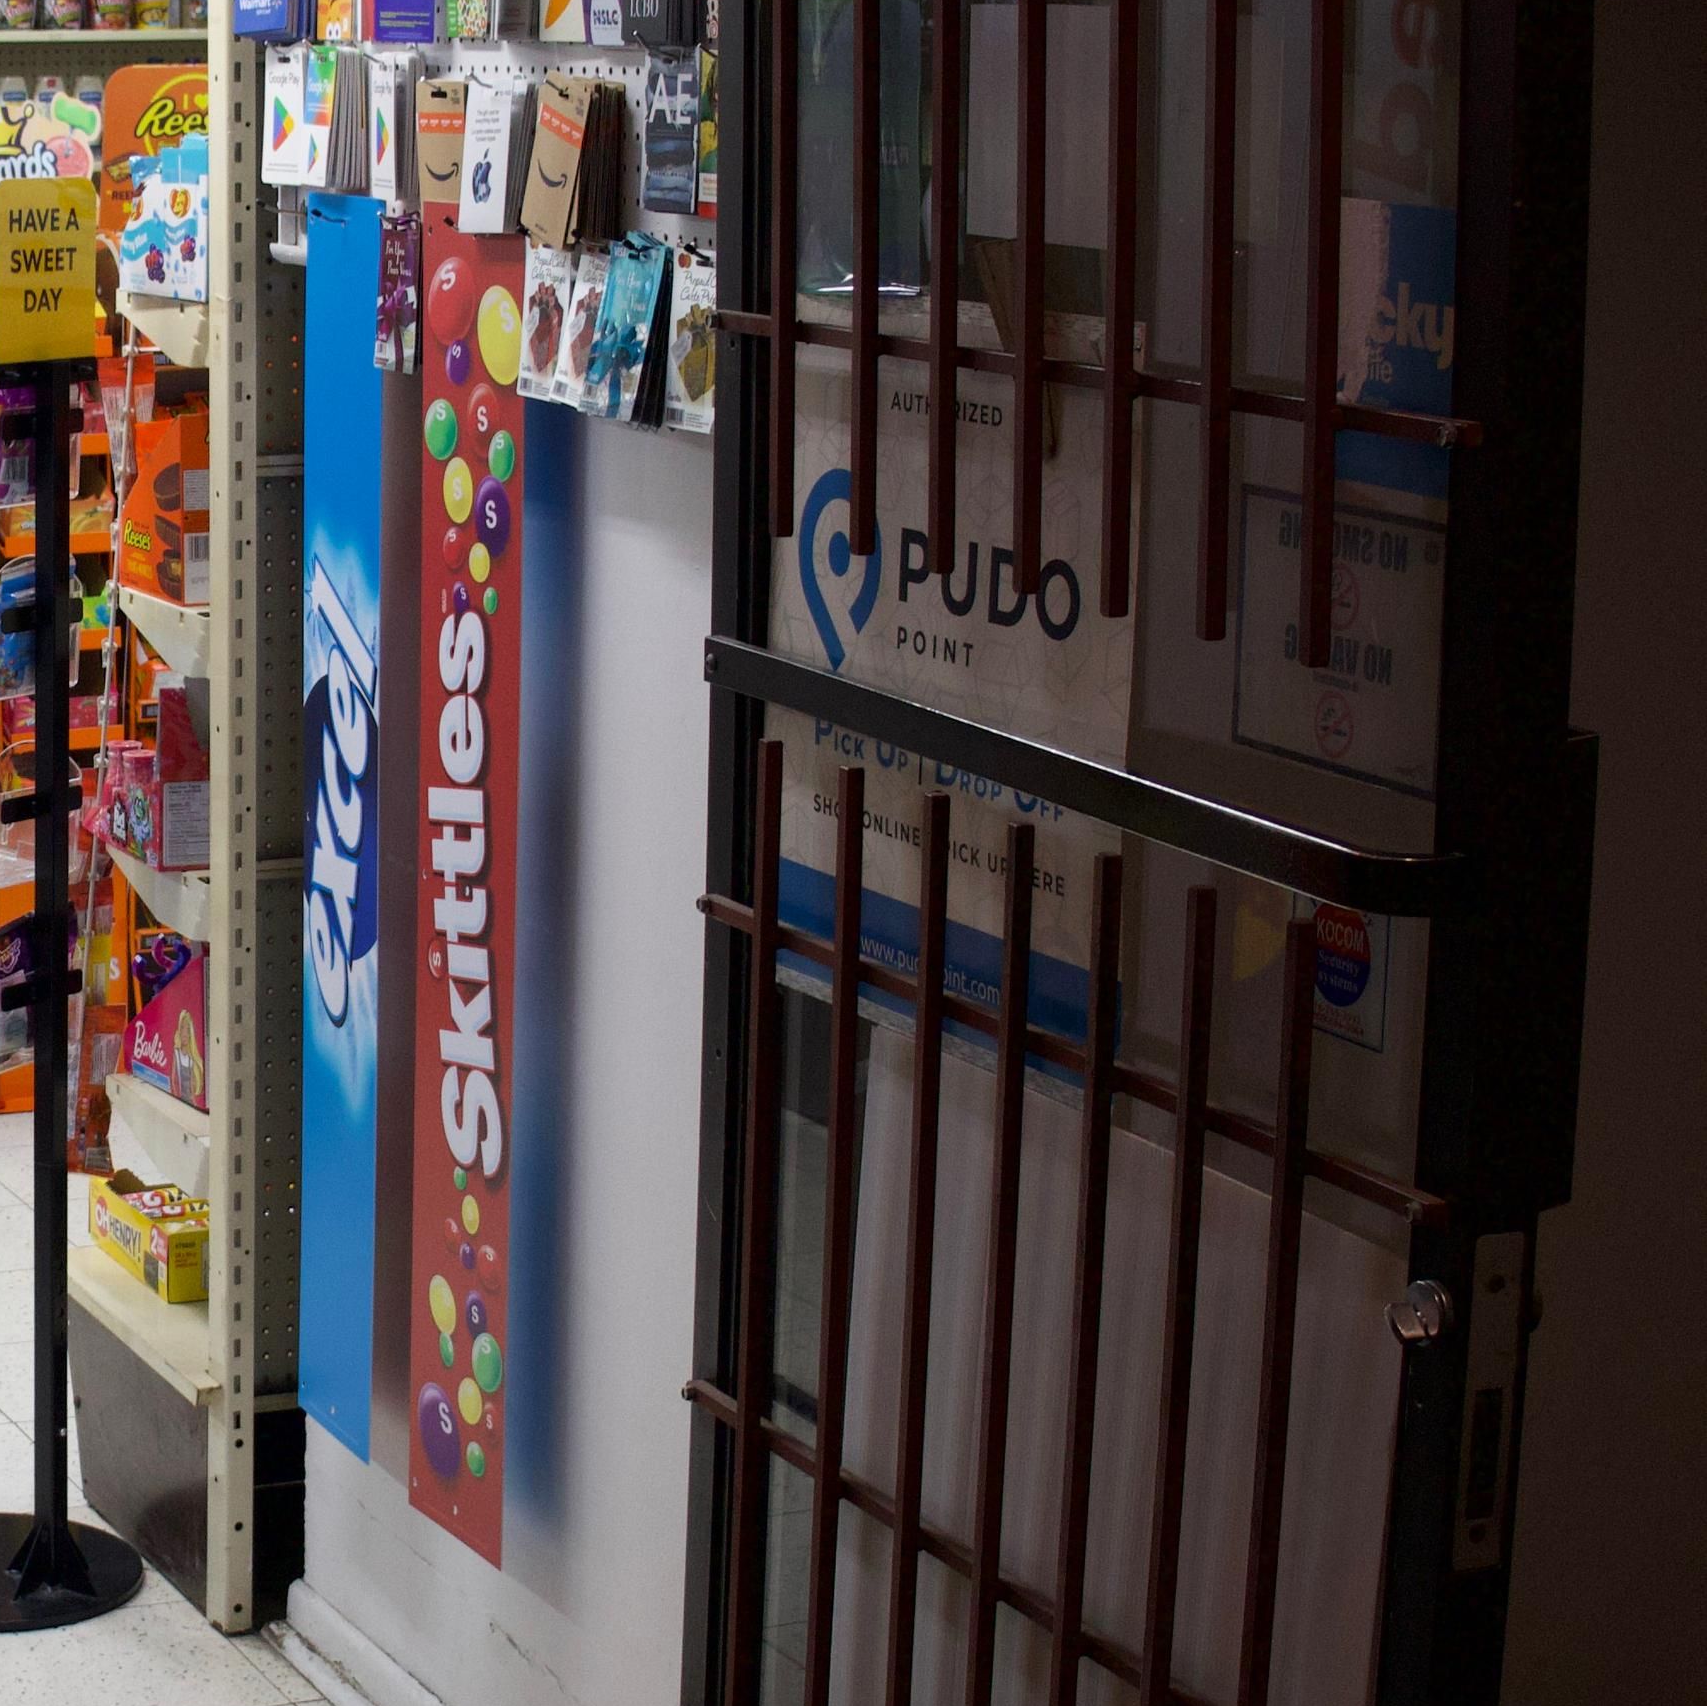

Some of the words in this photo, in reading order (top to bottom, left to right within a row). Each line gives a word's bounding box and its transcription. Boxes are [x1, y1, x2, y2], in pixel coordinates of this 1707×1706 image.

[593, 8, 619, 27] NSLC
[269, 71, 288, 86] Google
[288, 71, 300, 86] Play
[649, 73, 693, 124] AE
[9, 209, 60, 233] HAVE
[65, 208, 80, 231] A
[9, 247, 78, 273] SWEET
[23, 288, 62, 314] DAY
[123, 518, 152, 550] Reese's
[898, 527, 1081, 641] PUDO
[896, 626, 974, 667] POINT
[308, 553, 378, 1028] excel
[862, 809, 921, 846] ONLINE
[428, 610, 504, 1180] Skittles
[1316, 917, 1365, 955] KOCOM
[1317, 949, 1360, 978] Security
[133, 1020, 168, 1067] Barbie
[95, 1204, 108, 1232] OH
[109, 1215, 142, 1264] HENRY!
